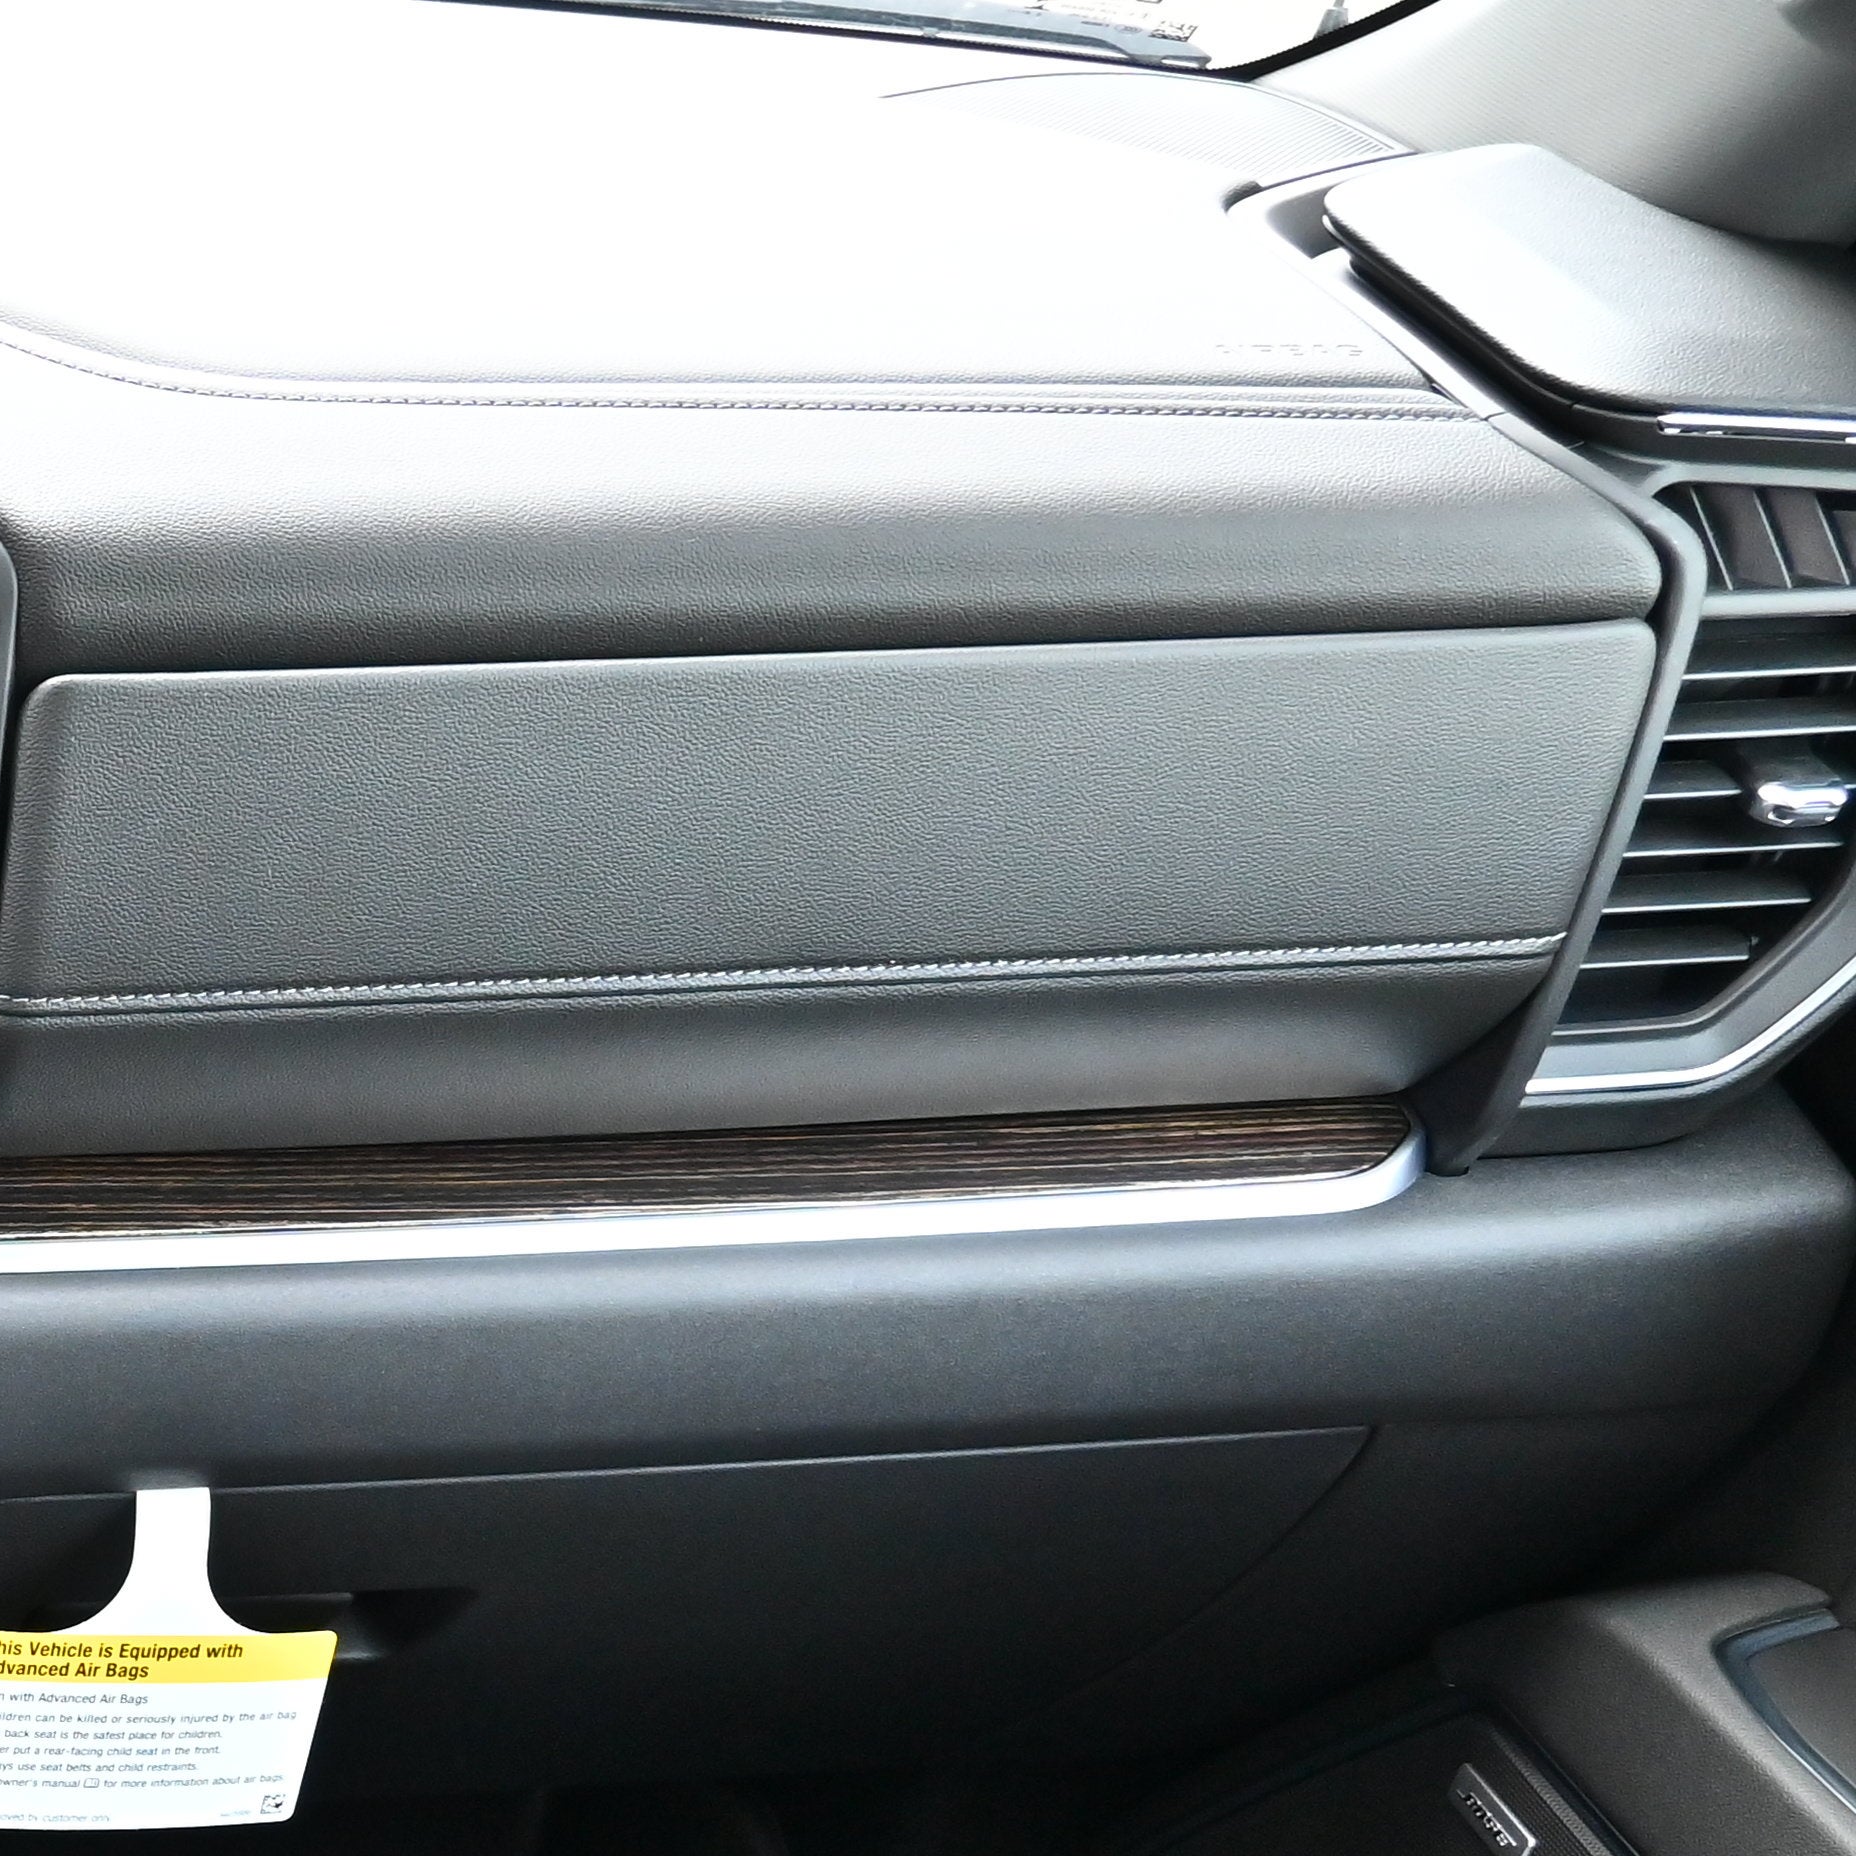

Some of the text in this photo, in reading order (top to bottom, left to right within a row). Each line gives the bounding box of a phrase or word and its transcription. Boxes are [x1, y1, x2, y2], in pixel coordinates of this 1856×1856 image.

[29, 1641, 92, 1658] Vehicle
[98, 1643, 113, 1658] is
[119, 1643, 201, 1661] Equipped
[206, 1644, 243, 1658] with
[75, 1662, 100, 1677] Air
[105, 1662, 149, 1681] Bags
[9, 1691, 34, 1702] with
[38, 1693, 96, 1704] Advanced
[99, 1694, 116, 1704] Air
[120, 1694, 149, 1706] Bags
[59, 1713, 72, 1723] be
